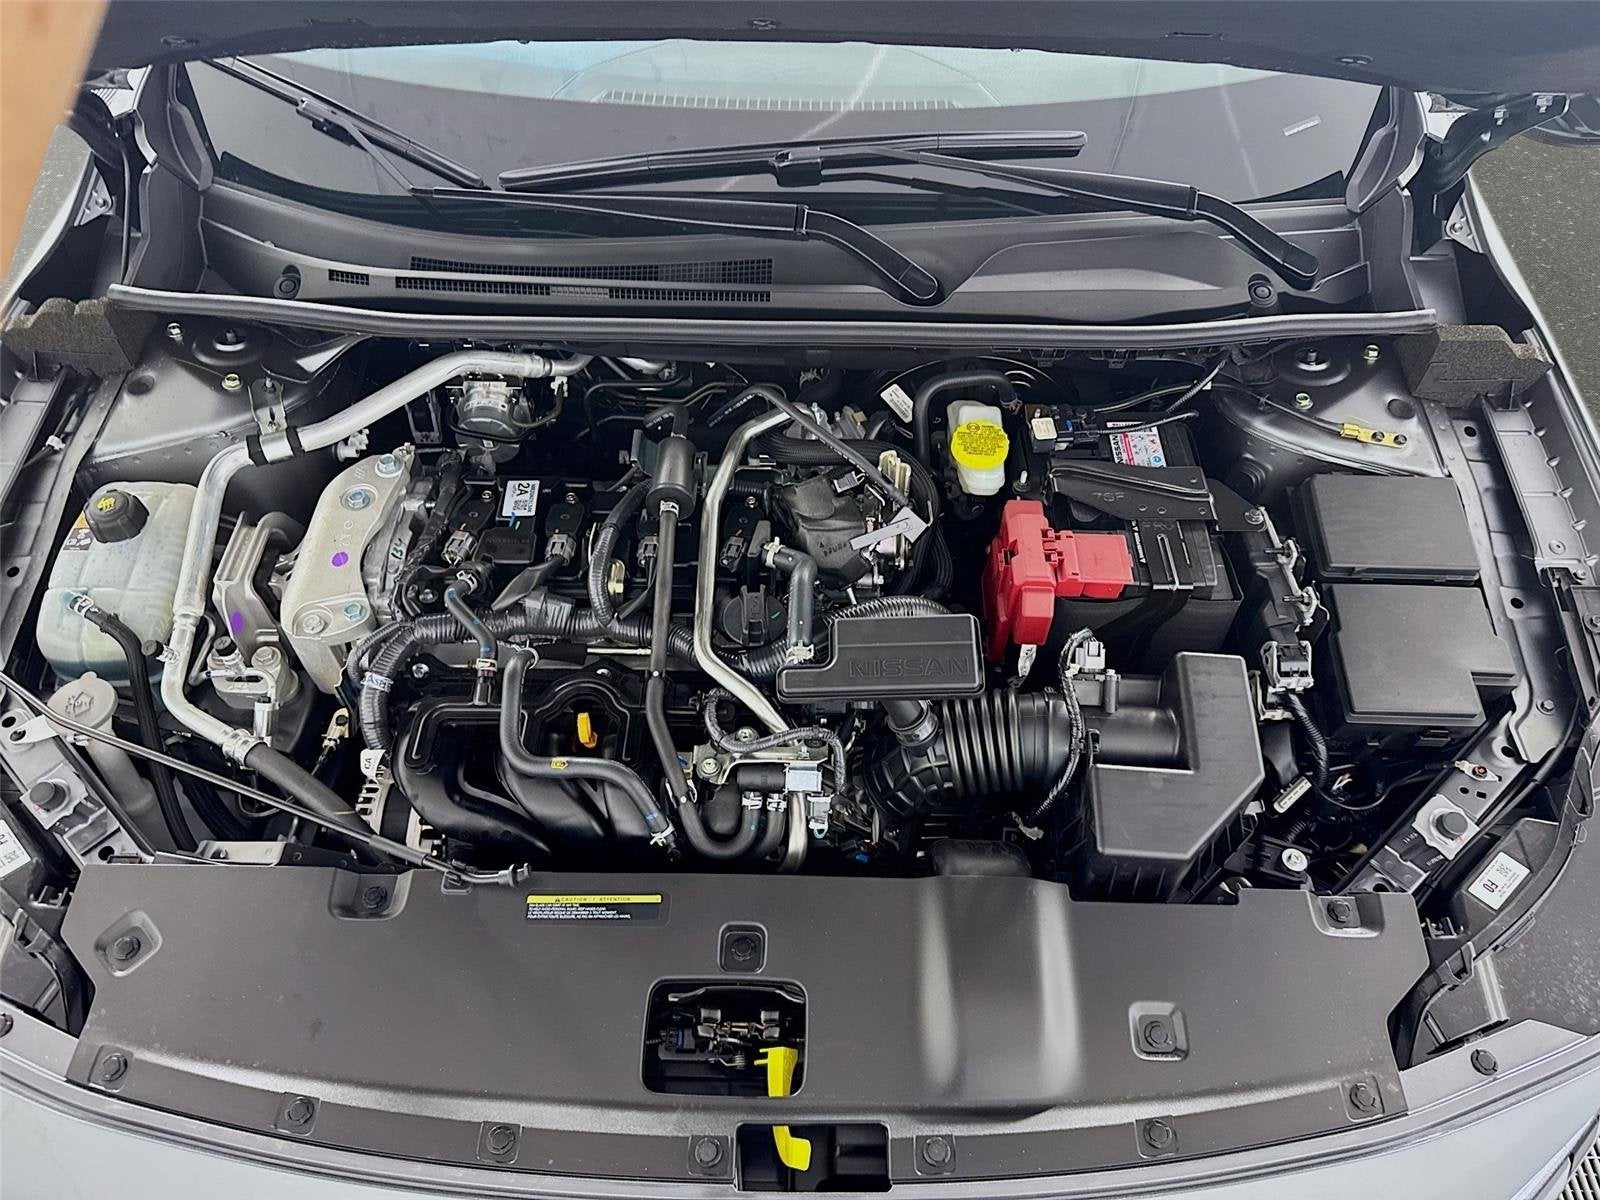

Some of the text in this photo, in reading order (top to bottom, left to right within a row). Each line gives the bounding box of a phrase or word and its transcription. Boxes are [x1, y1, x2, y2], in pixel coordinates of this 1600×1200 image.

[1112, 434, 1125, 464] NISSAN
[516, 482, 531, 497] 2A
[849, 657, 970, 678] NISSAN
